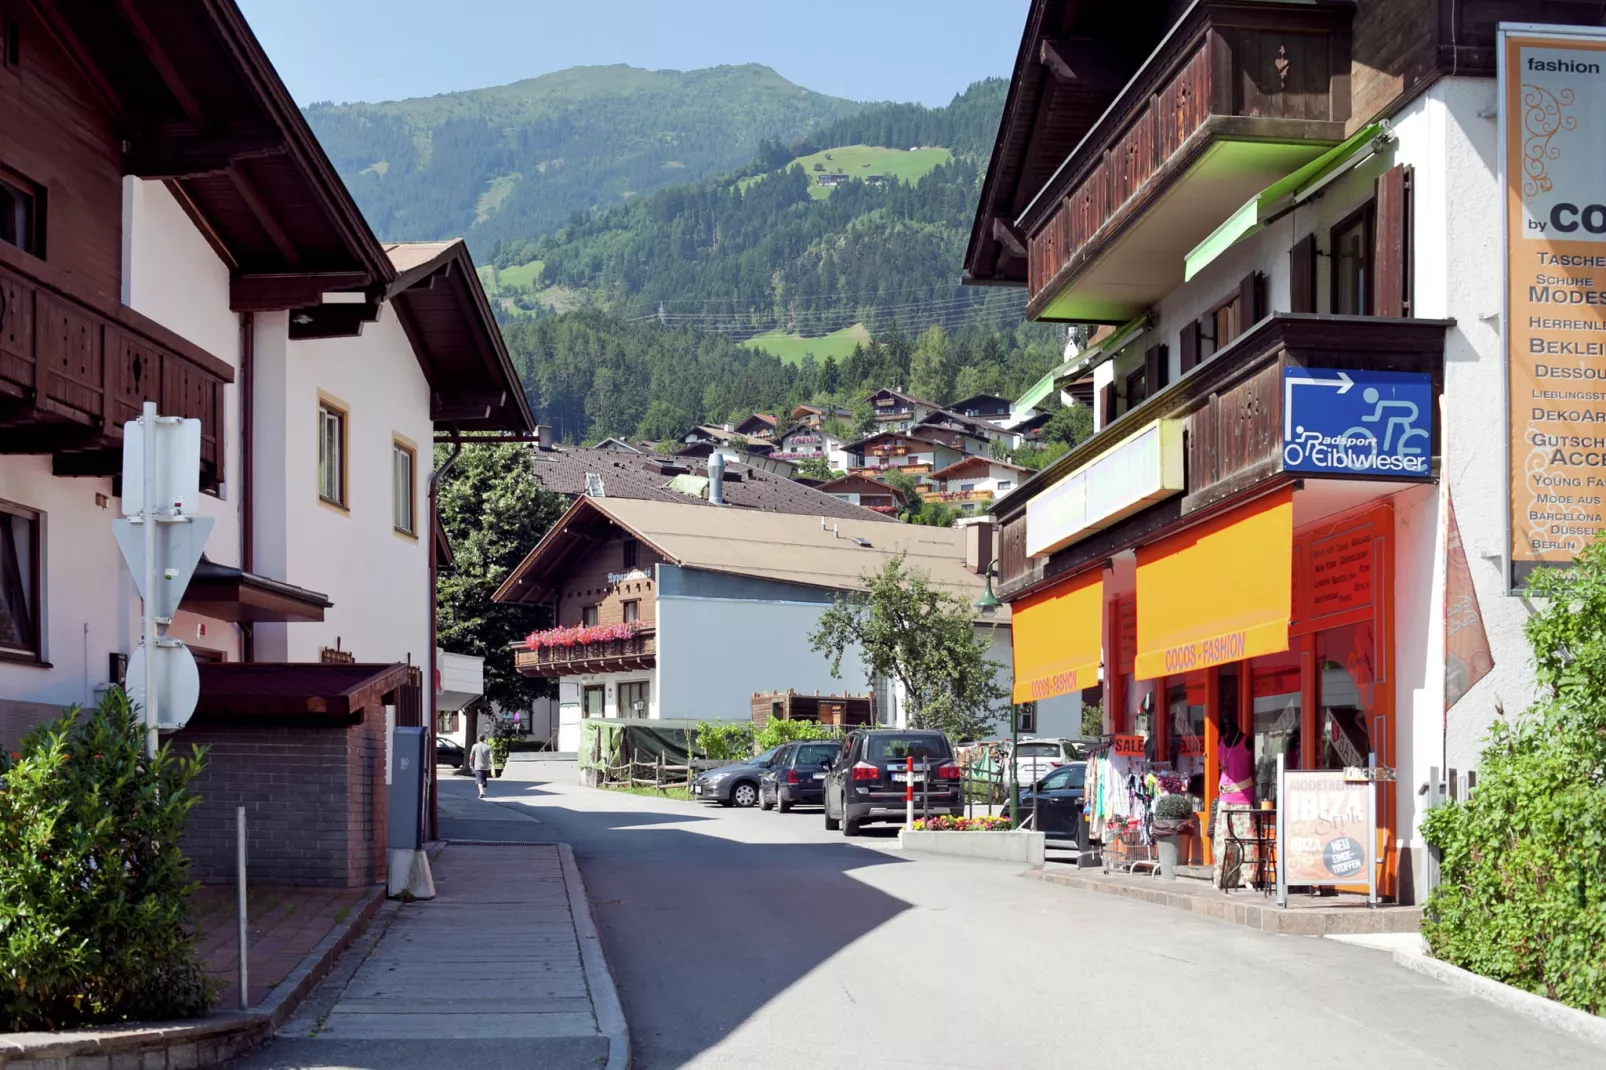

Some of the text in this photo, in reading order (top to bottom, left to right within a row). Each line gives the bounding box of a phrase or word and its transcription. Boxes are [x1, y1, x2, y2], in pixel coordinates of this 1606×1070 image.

[1527, 58, 1600, 74] fashion
[1528, 218, 1547, 232] by
[1536, 252, 1606, 267] TASCHE
[1536, 274, 1593, 287] SCHUHE
[1529, 338, 1604, 355] BEKLEI
[1304, 431, 1377, 454] Radsport
[1532, 433, 1606, 448] GUTSCH
[1312, 445, 1426, 471] Eiblwieser
[1533, 475, 1606, 488] YOUNG FA
[1536, 494, 1574, 504] MODE
[1529, 511, 1602, 522] BARCELONA
[1532, 539, 1576, 549] BERLIN
[1165, 643, 1196, 671] COCOS
[1202, 632, 1246, 664] FASHION
[1031, 678, 1050, 697] COCOS
[1053, 671, 1077, 694] FASHION
[1115, 738, 1144, 753] SALE
[1290, 791, 1365, 821] IBIZA
[1330, 838, 1350, 852] NEU
[1331, 859, 1362, 874] TROFFEN
